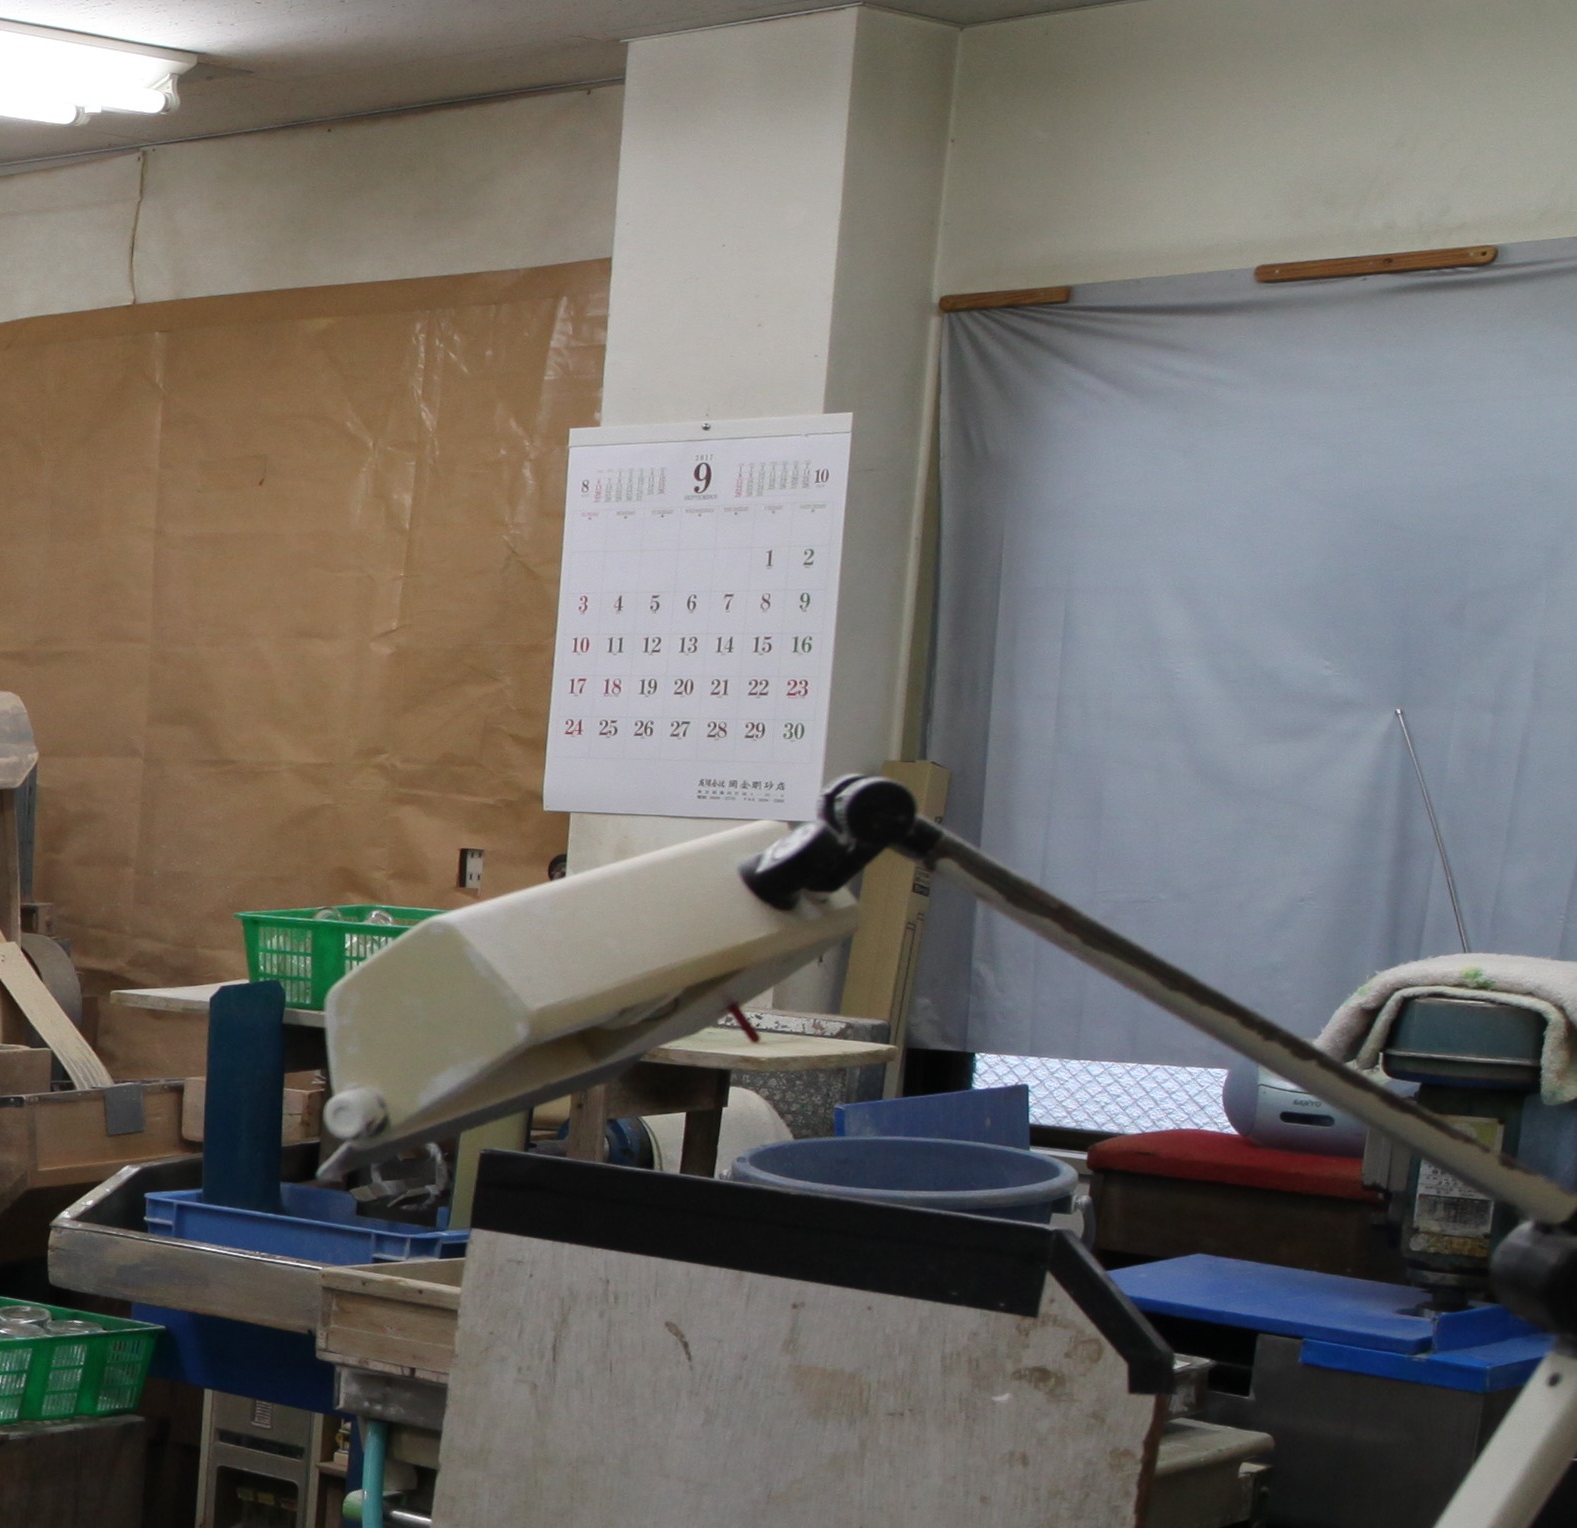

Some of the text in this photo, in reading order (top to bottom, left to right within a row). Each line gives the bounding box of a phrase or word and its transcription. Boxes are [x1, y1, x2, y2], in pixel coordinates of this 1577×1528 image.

[693, 462, 712, 494] 9
[814, 468, 830, 484] 10
[581, 480, 590, 493] 8
[766, 548, 815, 567] 1 2
[578, 593, 811, 613] 3 4 5 6 7 8 9
[572, 636, 813, 654] 10 11 12 13 14 15 16
[568, 678, 809, 697] 17 18 19 20 21 22 23
[564, 719, 805, 740] 24 25 26 27 28 29 30
